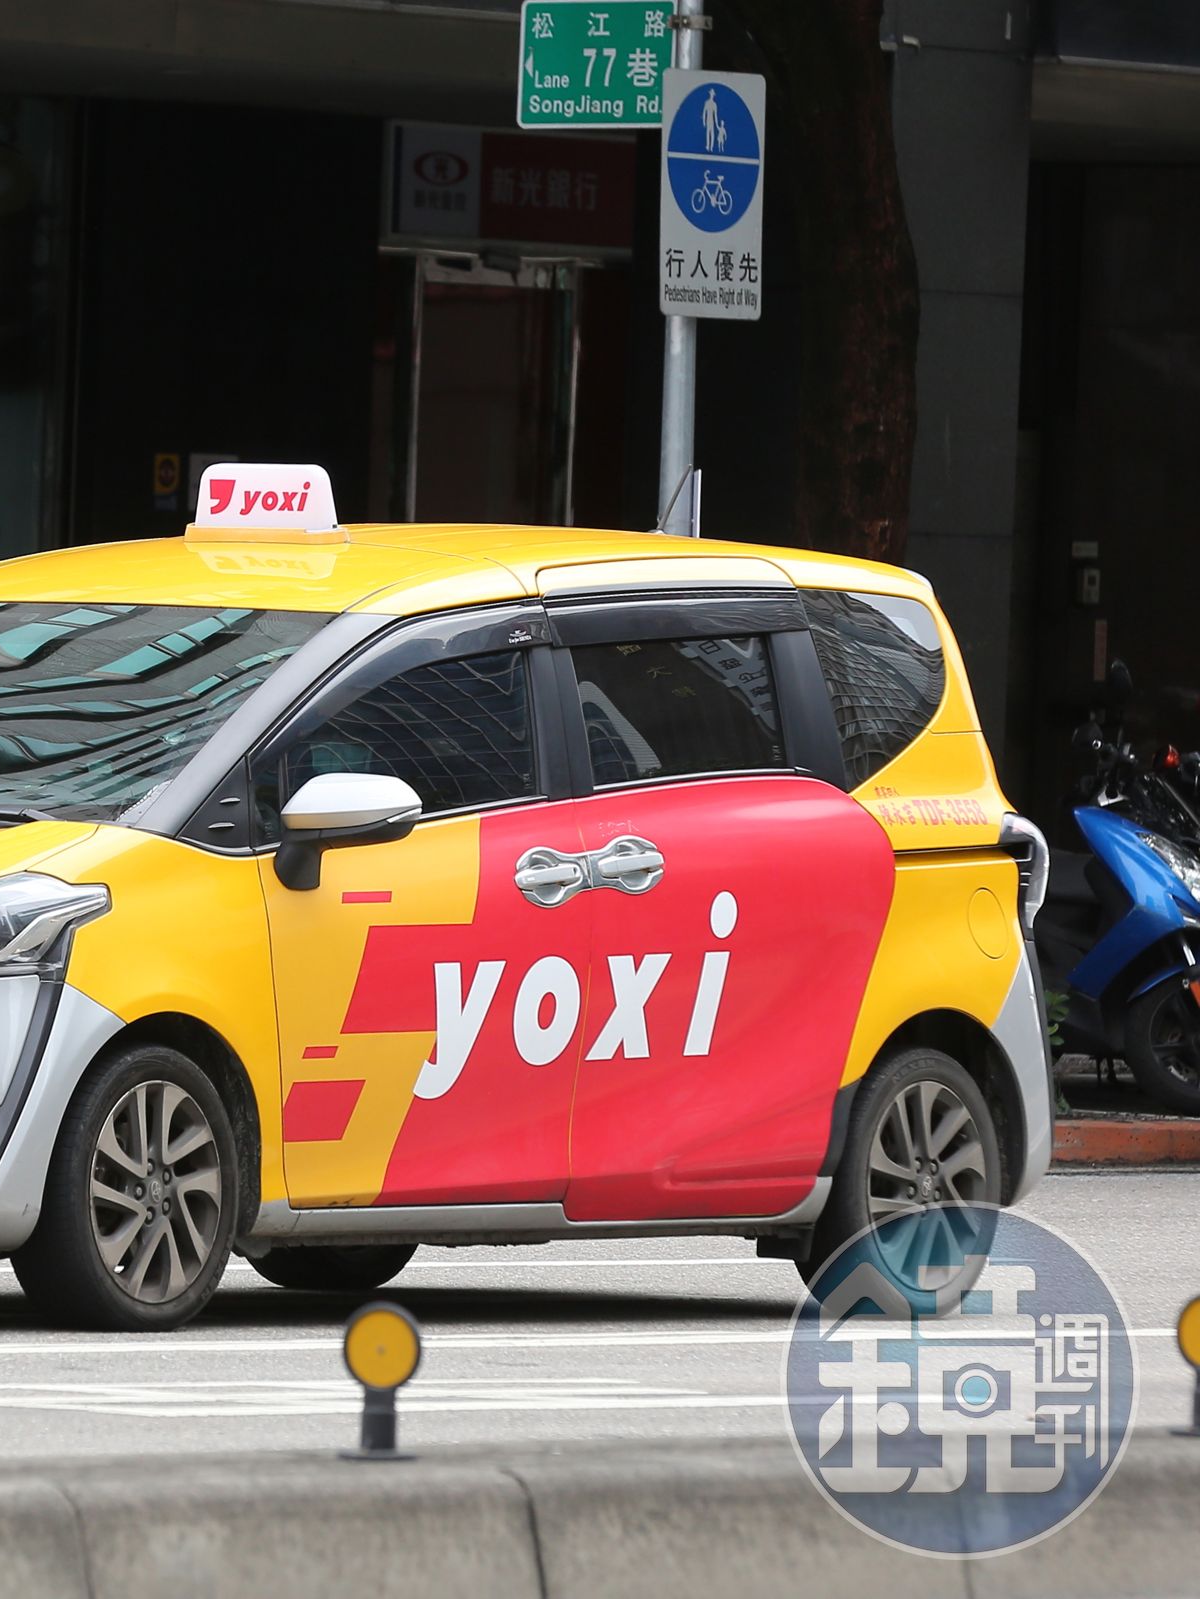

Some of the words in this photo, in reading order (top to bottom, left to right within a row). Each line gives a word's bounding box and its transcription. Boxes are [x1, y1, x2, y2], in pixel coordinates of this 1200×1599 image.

[531, 10, 666, 39] 松江路
[534, 70, 570, 88] Lane
[529, 95, 624, 117] SongJiang
[636, 95, 662, 114] Rd.
[491, 167, 599, 211] 新光銀行
[665, 248, 758, 283] 行人優先
[665, 284, 700, 304] Pedestrians
[701, 285, 717, 304] Have
[719, 287, 735, 309] Right
[736, 288, 743, 305] of
[744, 289, 758, 310] Way
[240, 481, 311, 516] yoxi
[413, 891, 739, 1100] yoxi
